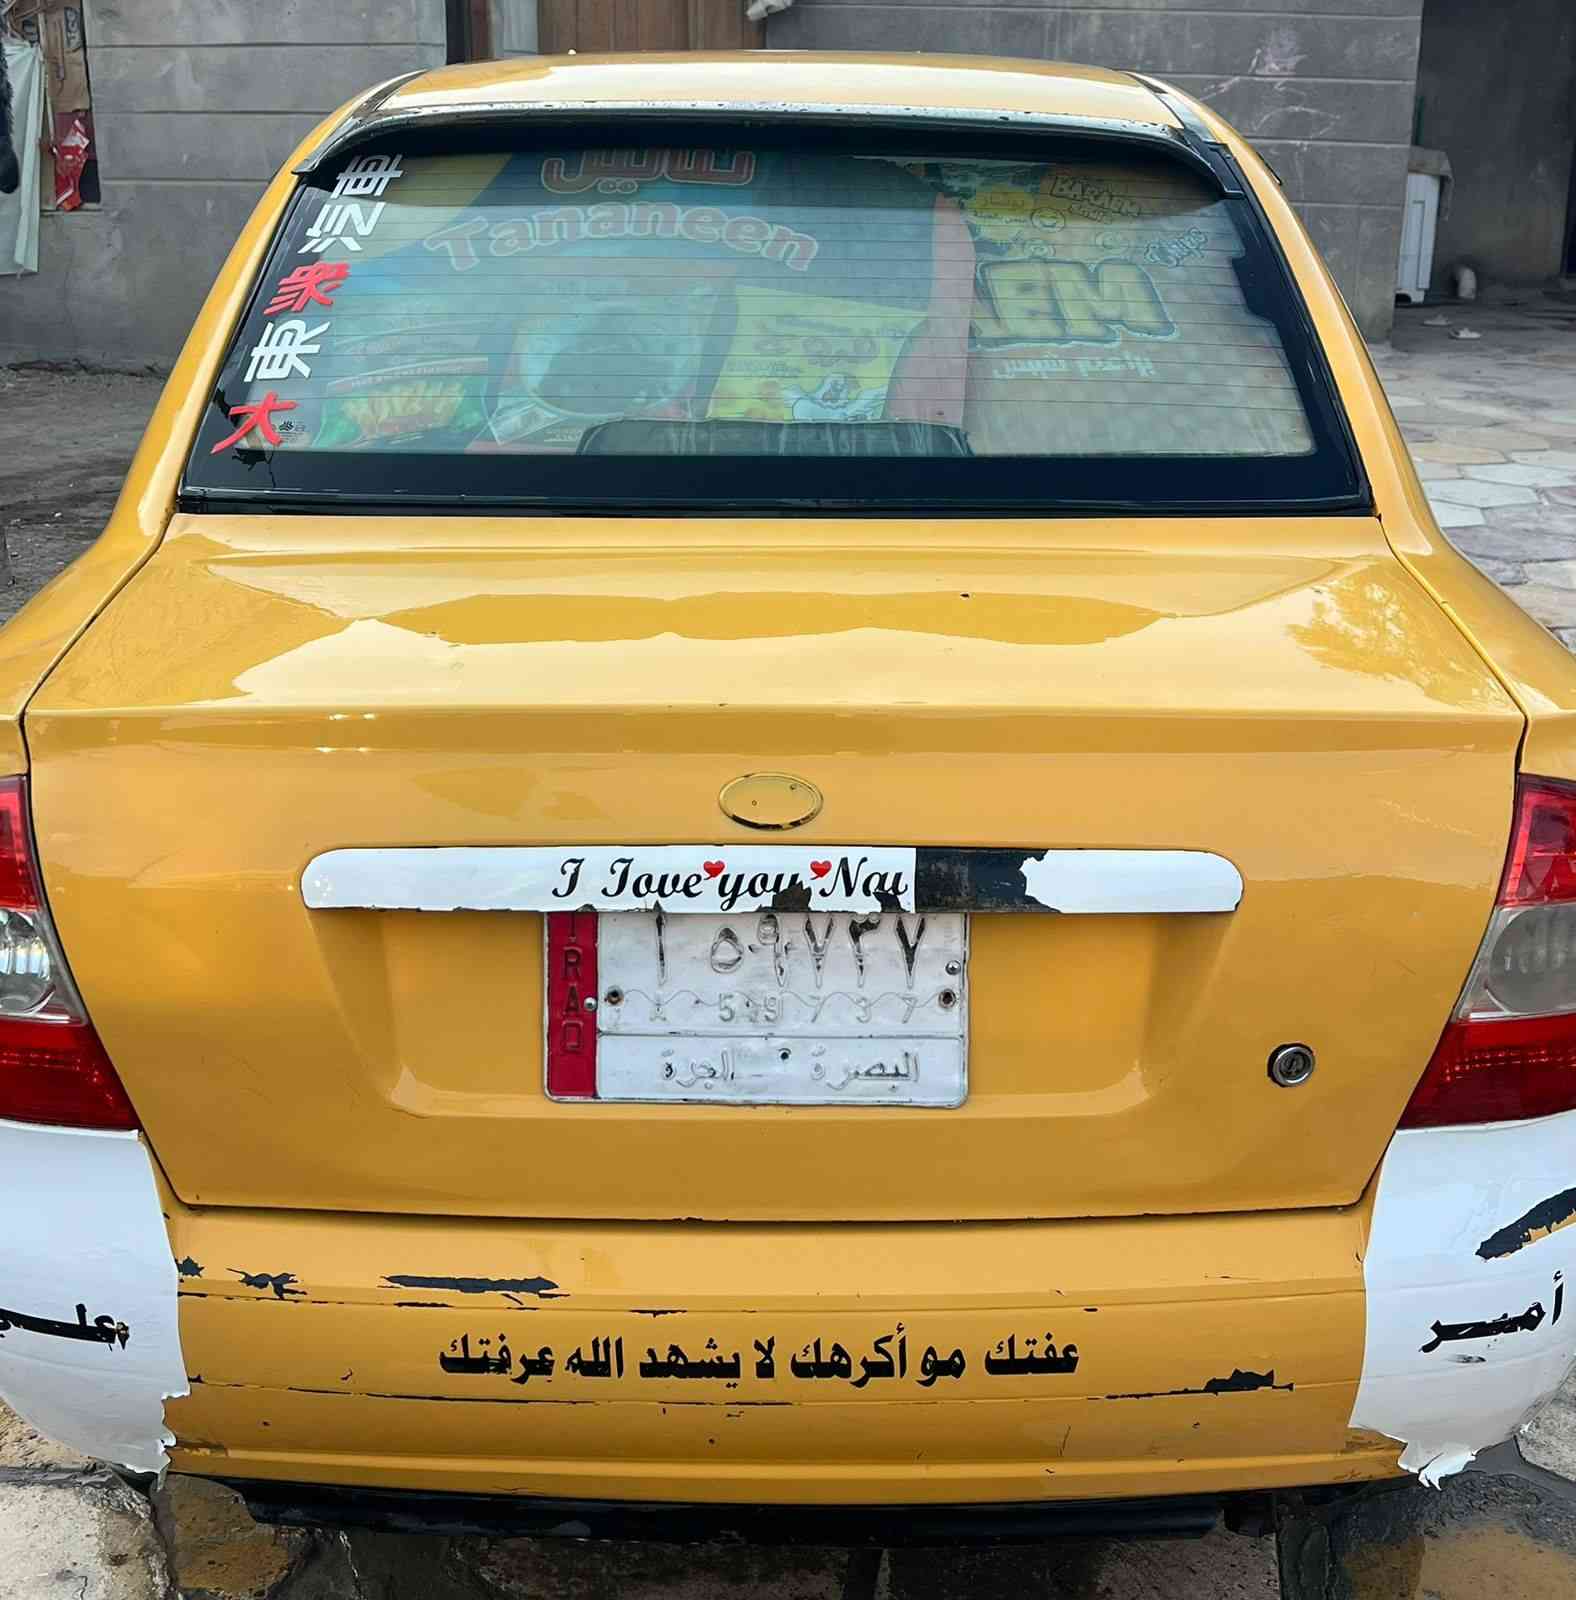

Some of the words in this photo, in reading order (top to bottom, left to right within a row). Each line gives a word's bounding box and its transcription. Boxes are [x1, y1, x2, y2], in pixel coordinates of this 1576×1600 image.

[423, 202, 819, 272] Tananeen
[717, 872, 802, 913] you
[438, 1332, 556, 1385] عرفتك
[564, 1335, 625, 1379] الله
[637, 1336, 742, 1389] يشهد
[752, 1335, 777, 1380] لا
[789, 1321, 908, 1389] أكرهك
[915, 1345, 967, 1388] مو
[983, 1331, 1080, 1376] عفتك
